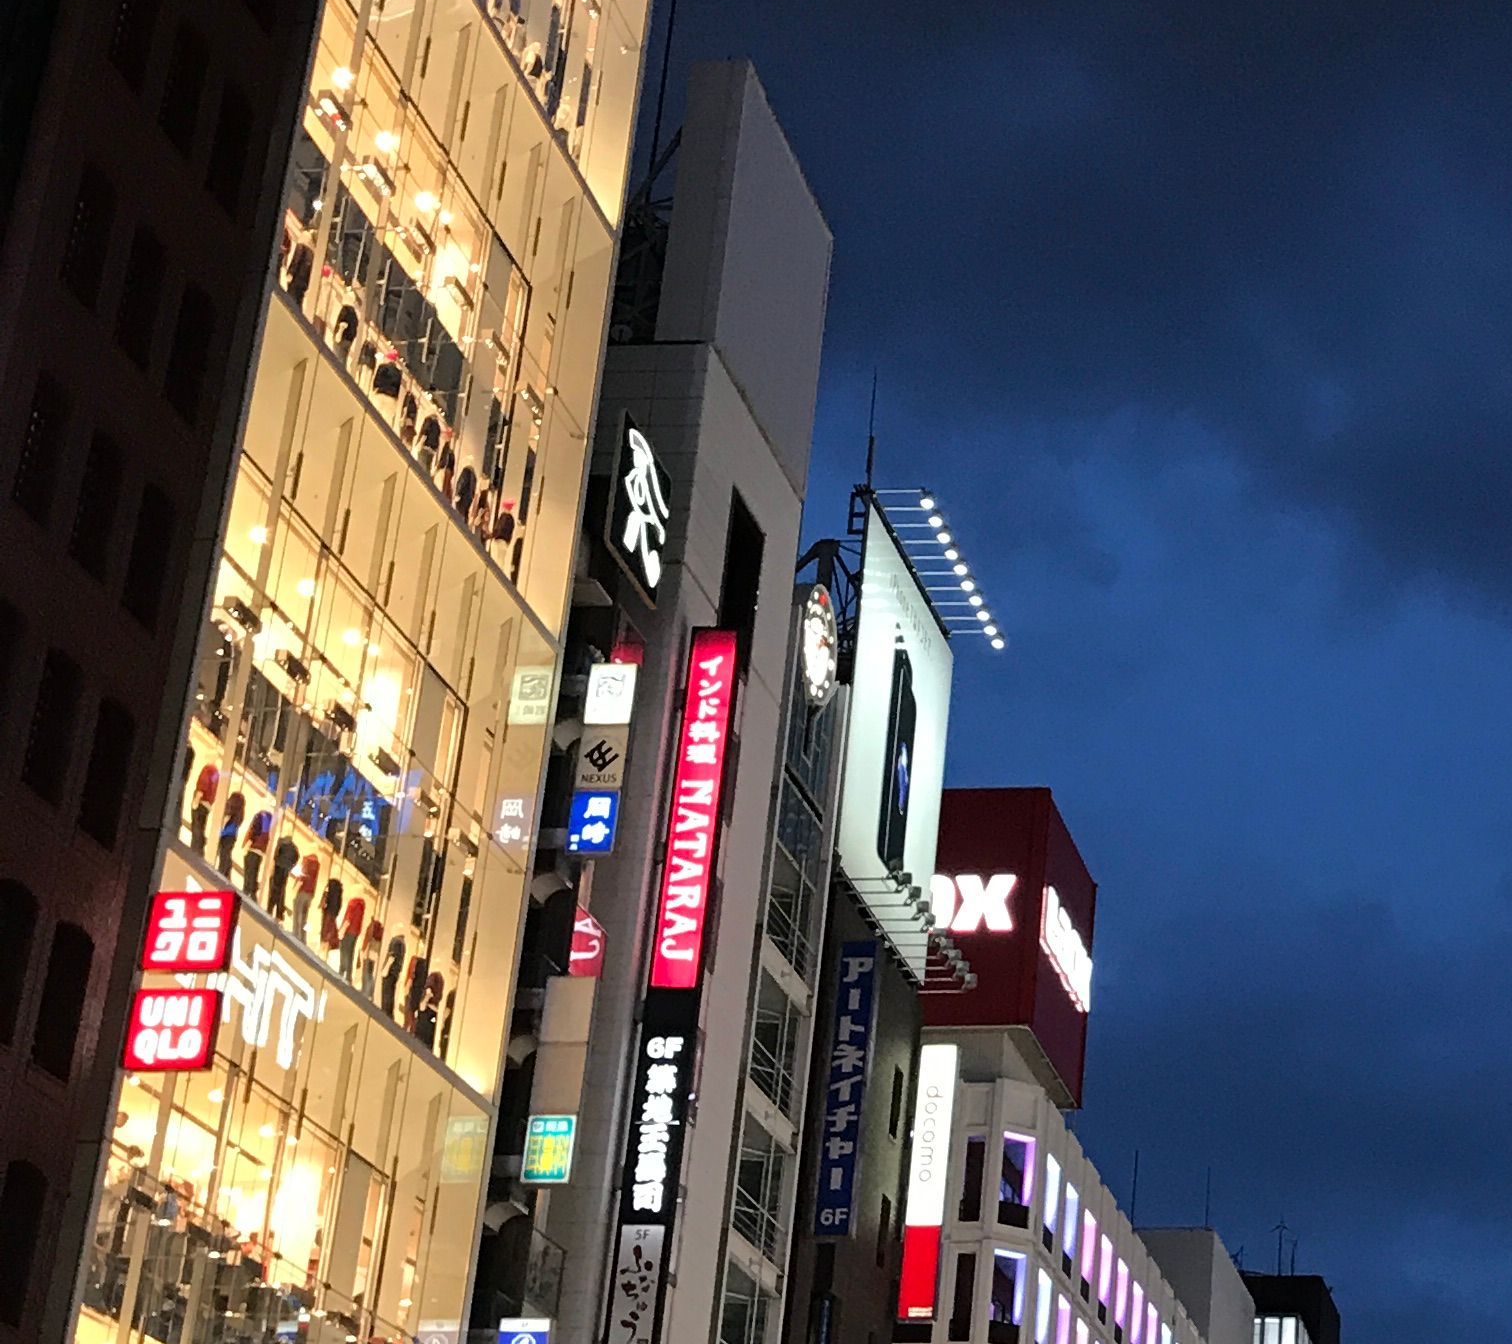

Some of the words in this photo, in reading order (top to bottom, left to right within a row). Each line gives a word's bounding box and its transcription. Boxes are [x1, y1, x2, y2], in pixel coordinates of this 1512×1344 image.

[580, 772, 617, 784] NEXUS
[660, 779, 714, 961] NATARAJ
[140, 996, 202, 1027] UNI
[133, 1028, 202, 1064] QLO
[647, 1037, 684, 1059] 6F
[824, 956, 874, 1192] アートネイチャー
[917, 1085, 944, 1184] docomo
[820, 1207, 849, 1226] 6F
